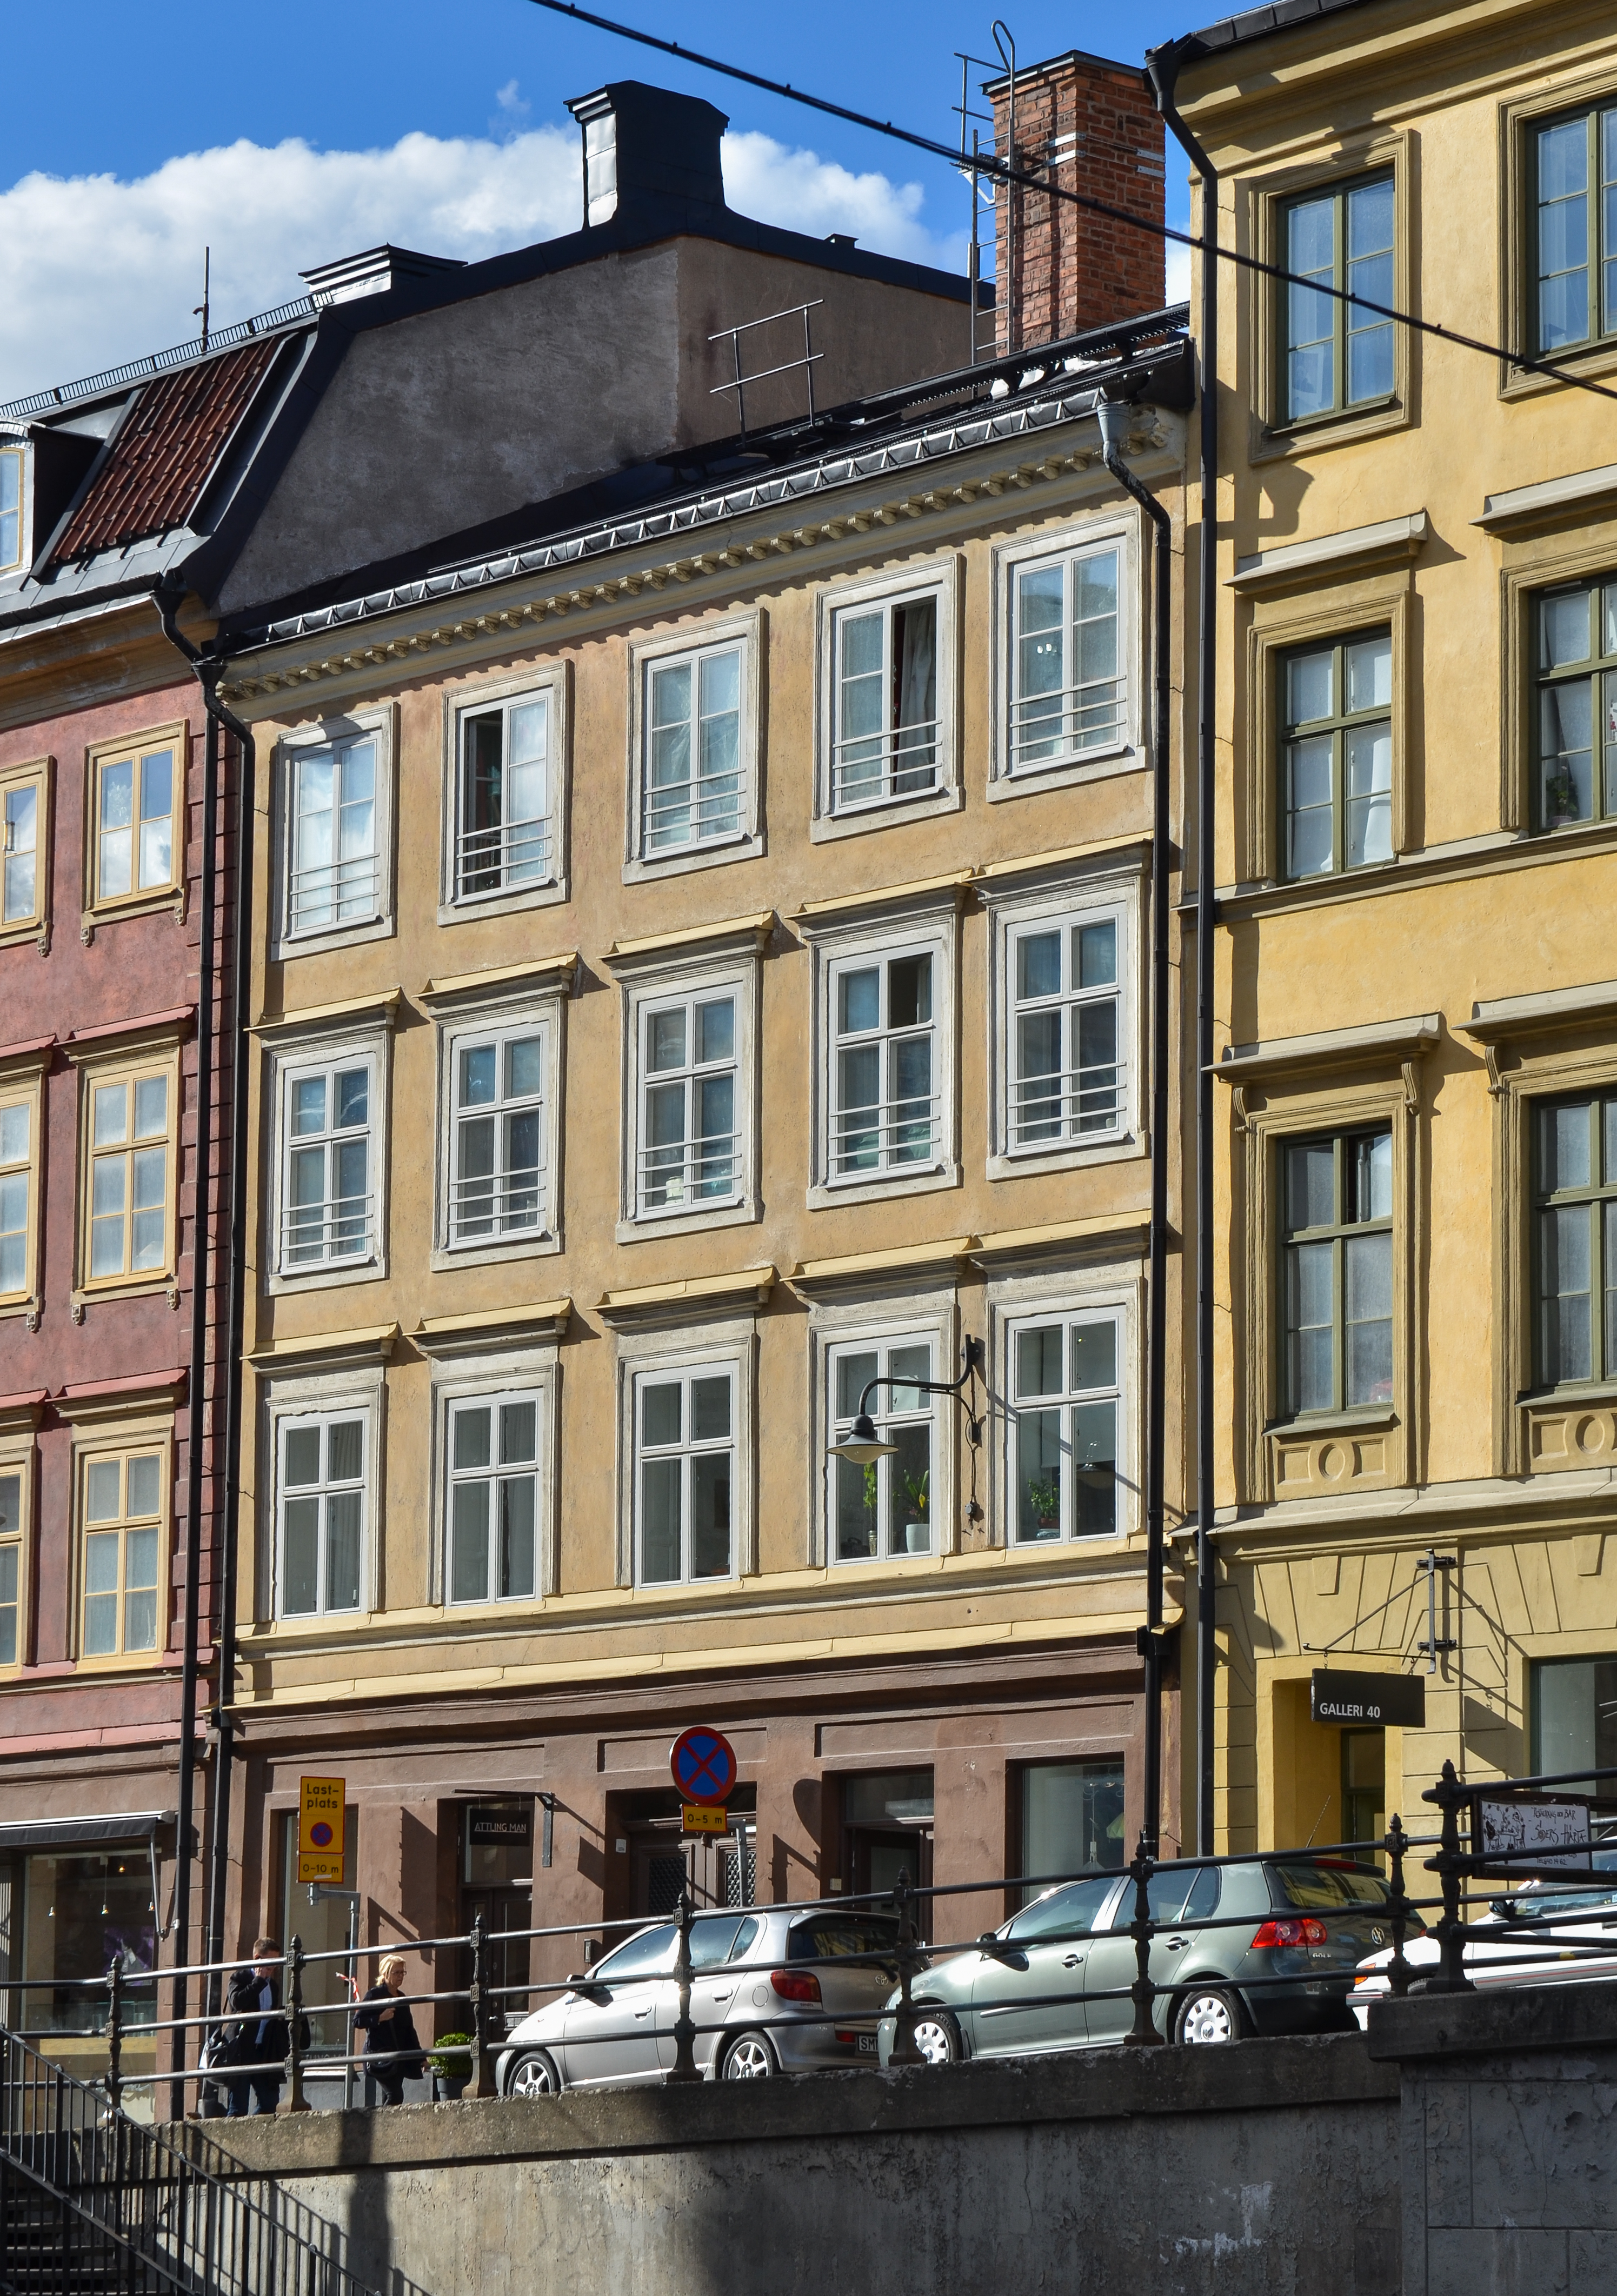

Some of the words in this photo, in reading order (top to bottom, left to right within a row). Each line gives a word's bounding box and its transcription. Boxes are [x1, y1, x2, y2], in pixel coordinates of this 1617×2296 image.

[1320, 1703, 1363, 1717] GALLERI
[1367, 1706, 1380, 1718] 40
[307, 1784, 339, 1795] Last-
[307, 1798, 338, 1810] plats
[687, 1813, 708, 1824] 0-5
[1564, 1808, 1576, 1820] BAR
[474, 1822, 507, 1832] ATTLING
[509, 1823, 527, 1832] MAN
[302, 1864, 327, 1873] 0-10
[861, 2037, 879, 2051] SM
